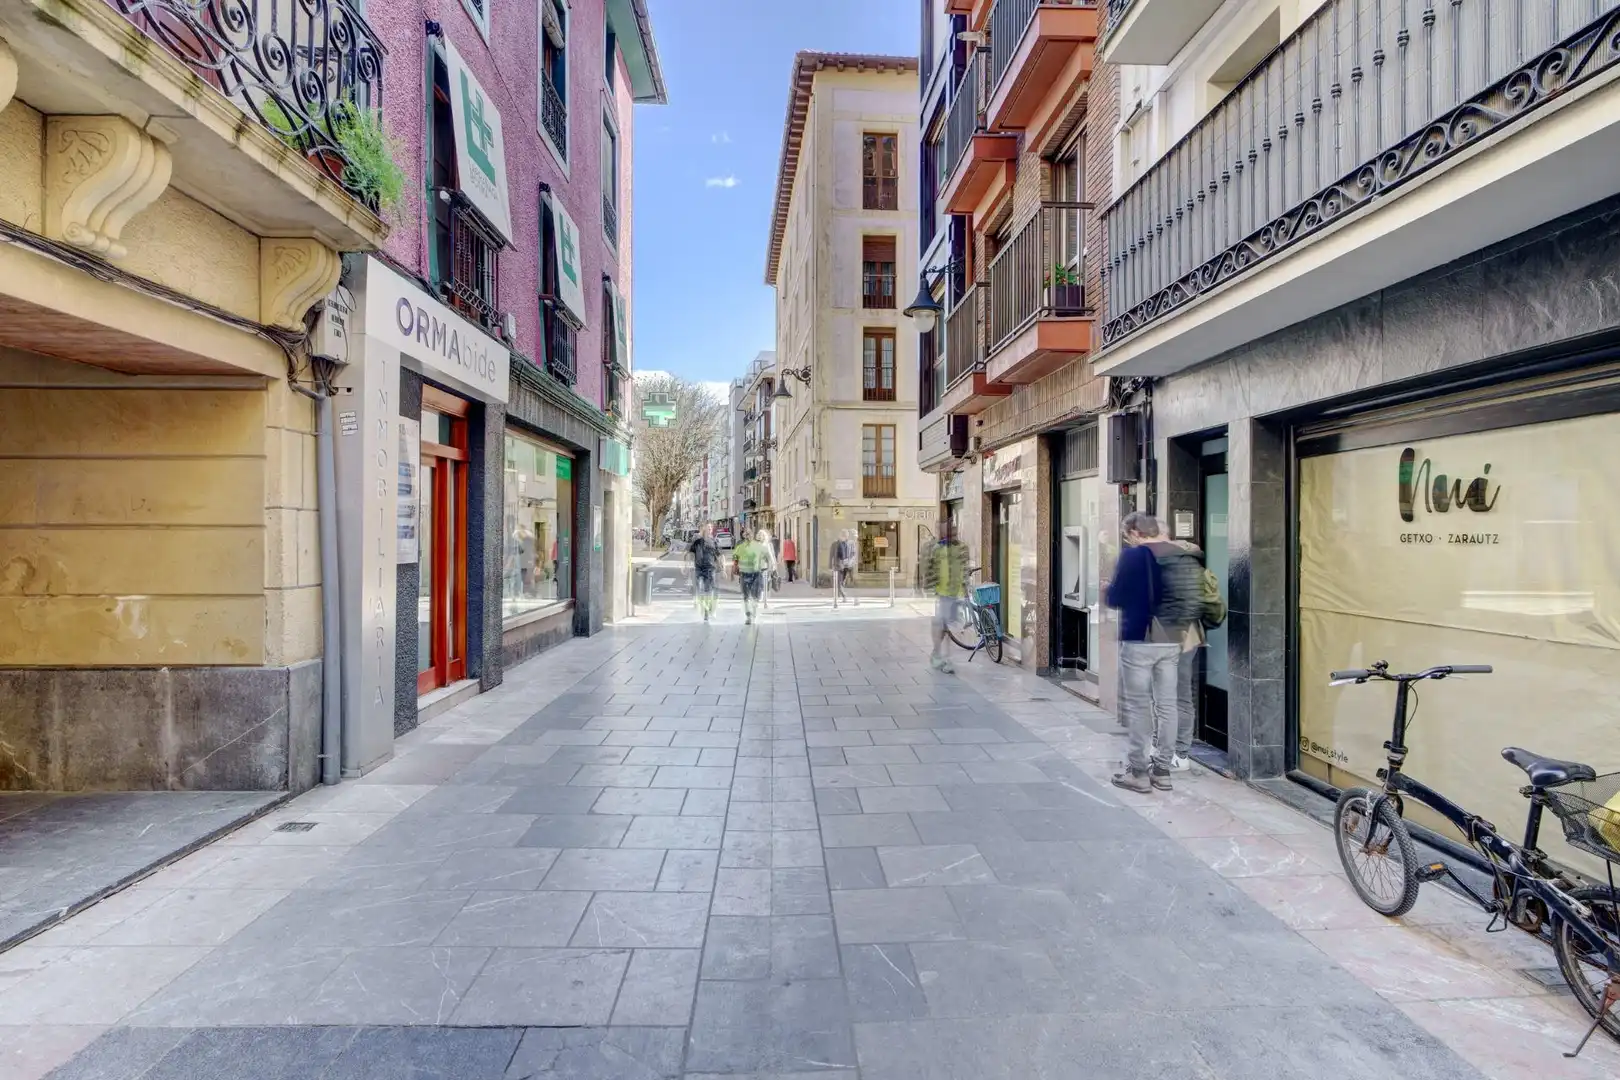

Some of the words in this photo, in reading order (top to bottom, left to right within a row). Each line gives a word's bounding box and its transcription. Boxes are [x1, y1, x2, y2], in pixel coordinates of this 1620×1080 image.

[396, 297, 496, 383] ORMAbide
[373, 360, 389, 707] INMOBILIARIA
[1399, 533, 1433, 543] GETXO
[1447, 533, 1499, 544] ZARAUTZ
